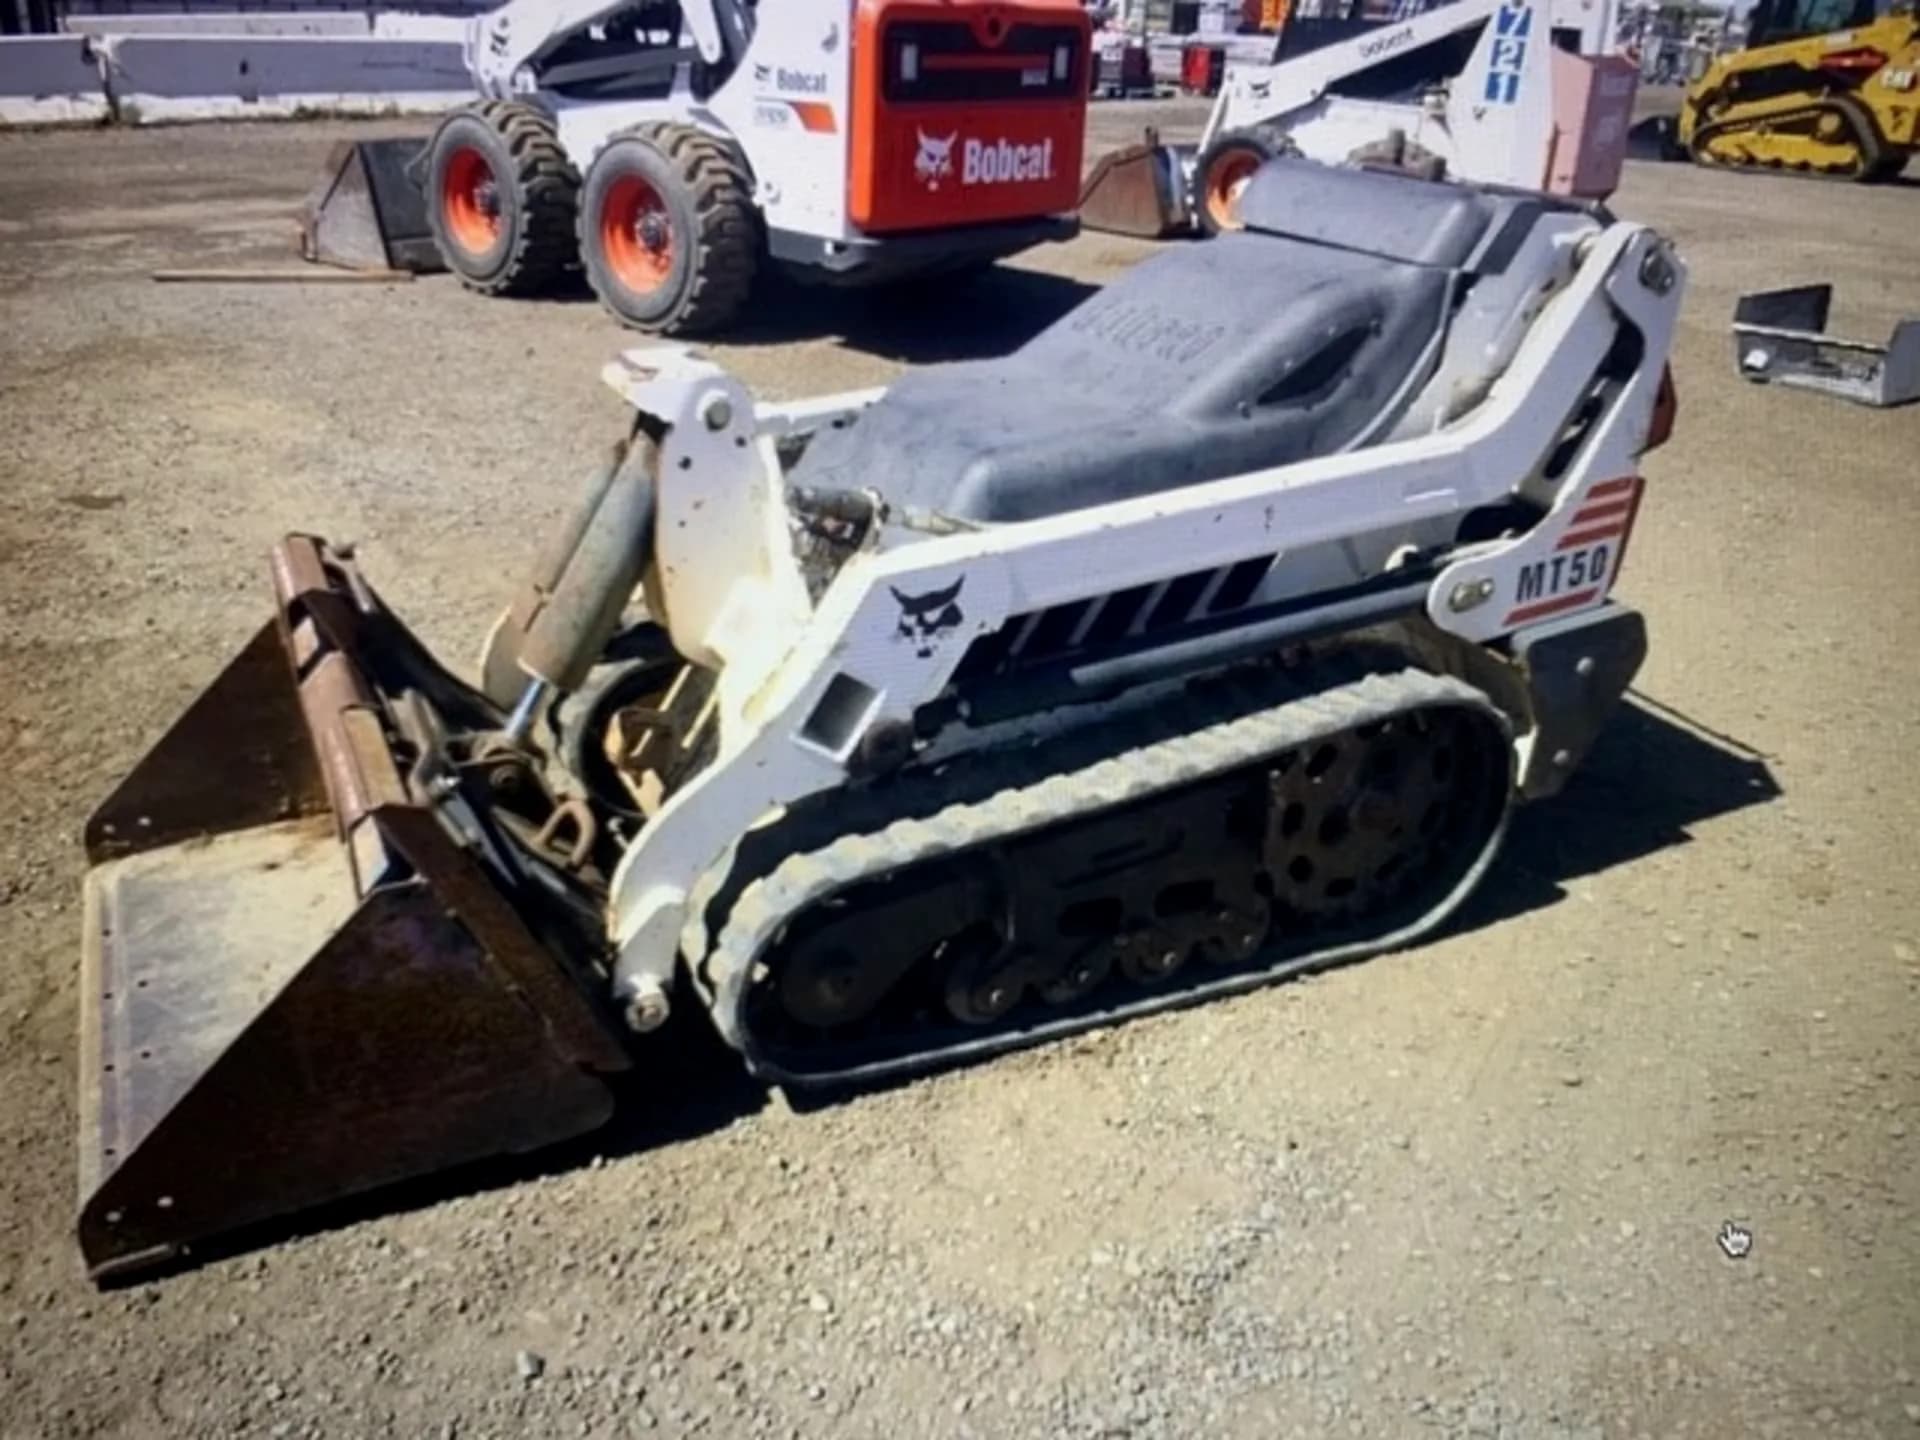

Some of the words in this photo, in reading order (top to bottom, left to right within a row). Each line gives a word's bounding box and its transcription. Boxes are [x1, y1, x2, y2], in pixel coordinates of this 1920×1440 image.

[777, 68, 827, 92] Bobcat
[1489, 5, 1531, 103] 721
[962, 137, 1053, 185] Bobcat
[1515, 545, 1608, 602] MT50
